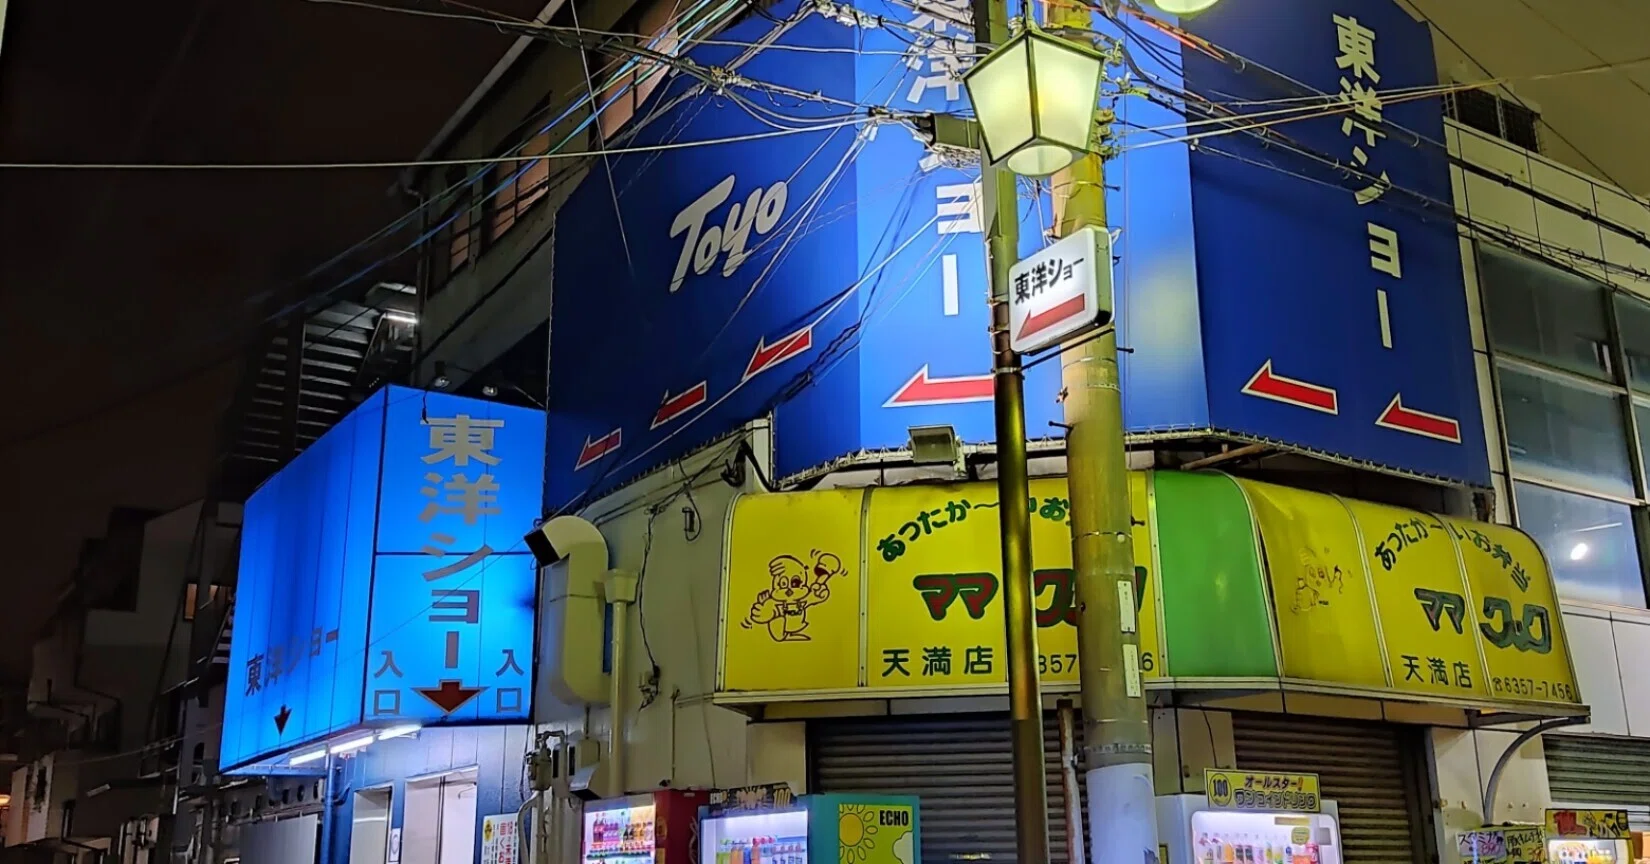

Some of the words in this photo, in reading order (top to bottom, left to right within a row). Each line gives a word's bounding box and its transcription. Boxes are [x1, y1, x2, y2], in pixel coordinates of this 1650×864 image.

[1332, 13, 1402, 349] 東洋ショー
[669, 174, 788, 292] Toyo
[1014, 257, 1085, 305] 東洋ショー
[419, 414, 505, 669] 東洋ショー
[374, 650, 403, 716] 入口
[495, 648, 525, 714] 入口
[881, 645, 993, 678] 天満店
[1401, 654, 1473, 689] 天満店
[879, 809, 909, 827] ECHO
